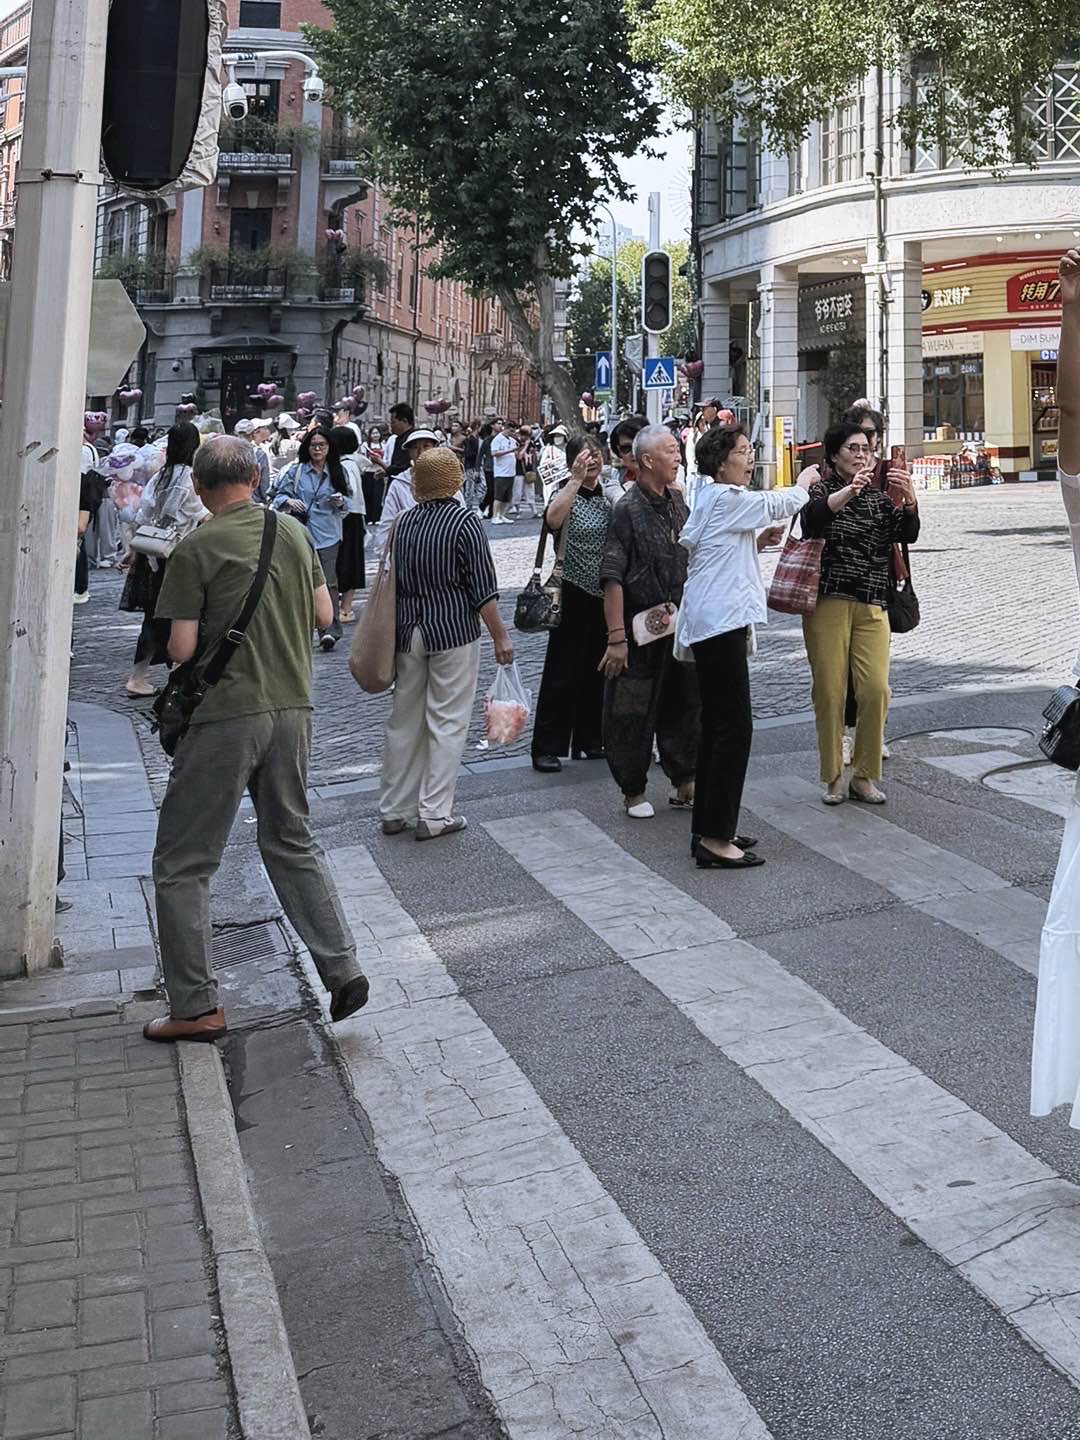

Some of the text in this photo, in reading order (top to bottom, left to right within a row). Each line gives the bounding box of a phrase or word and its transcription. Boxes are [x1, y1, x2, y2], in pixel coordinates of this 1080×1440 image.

[933, 286, 972, 308] 武汉特产
[1020, 279, 1062, 302] 转角7
[1020, 333, 1038, 344] DIM
